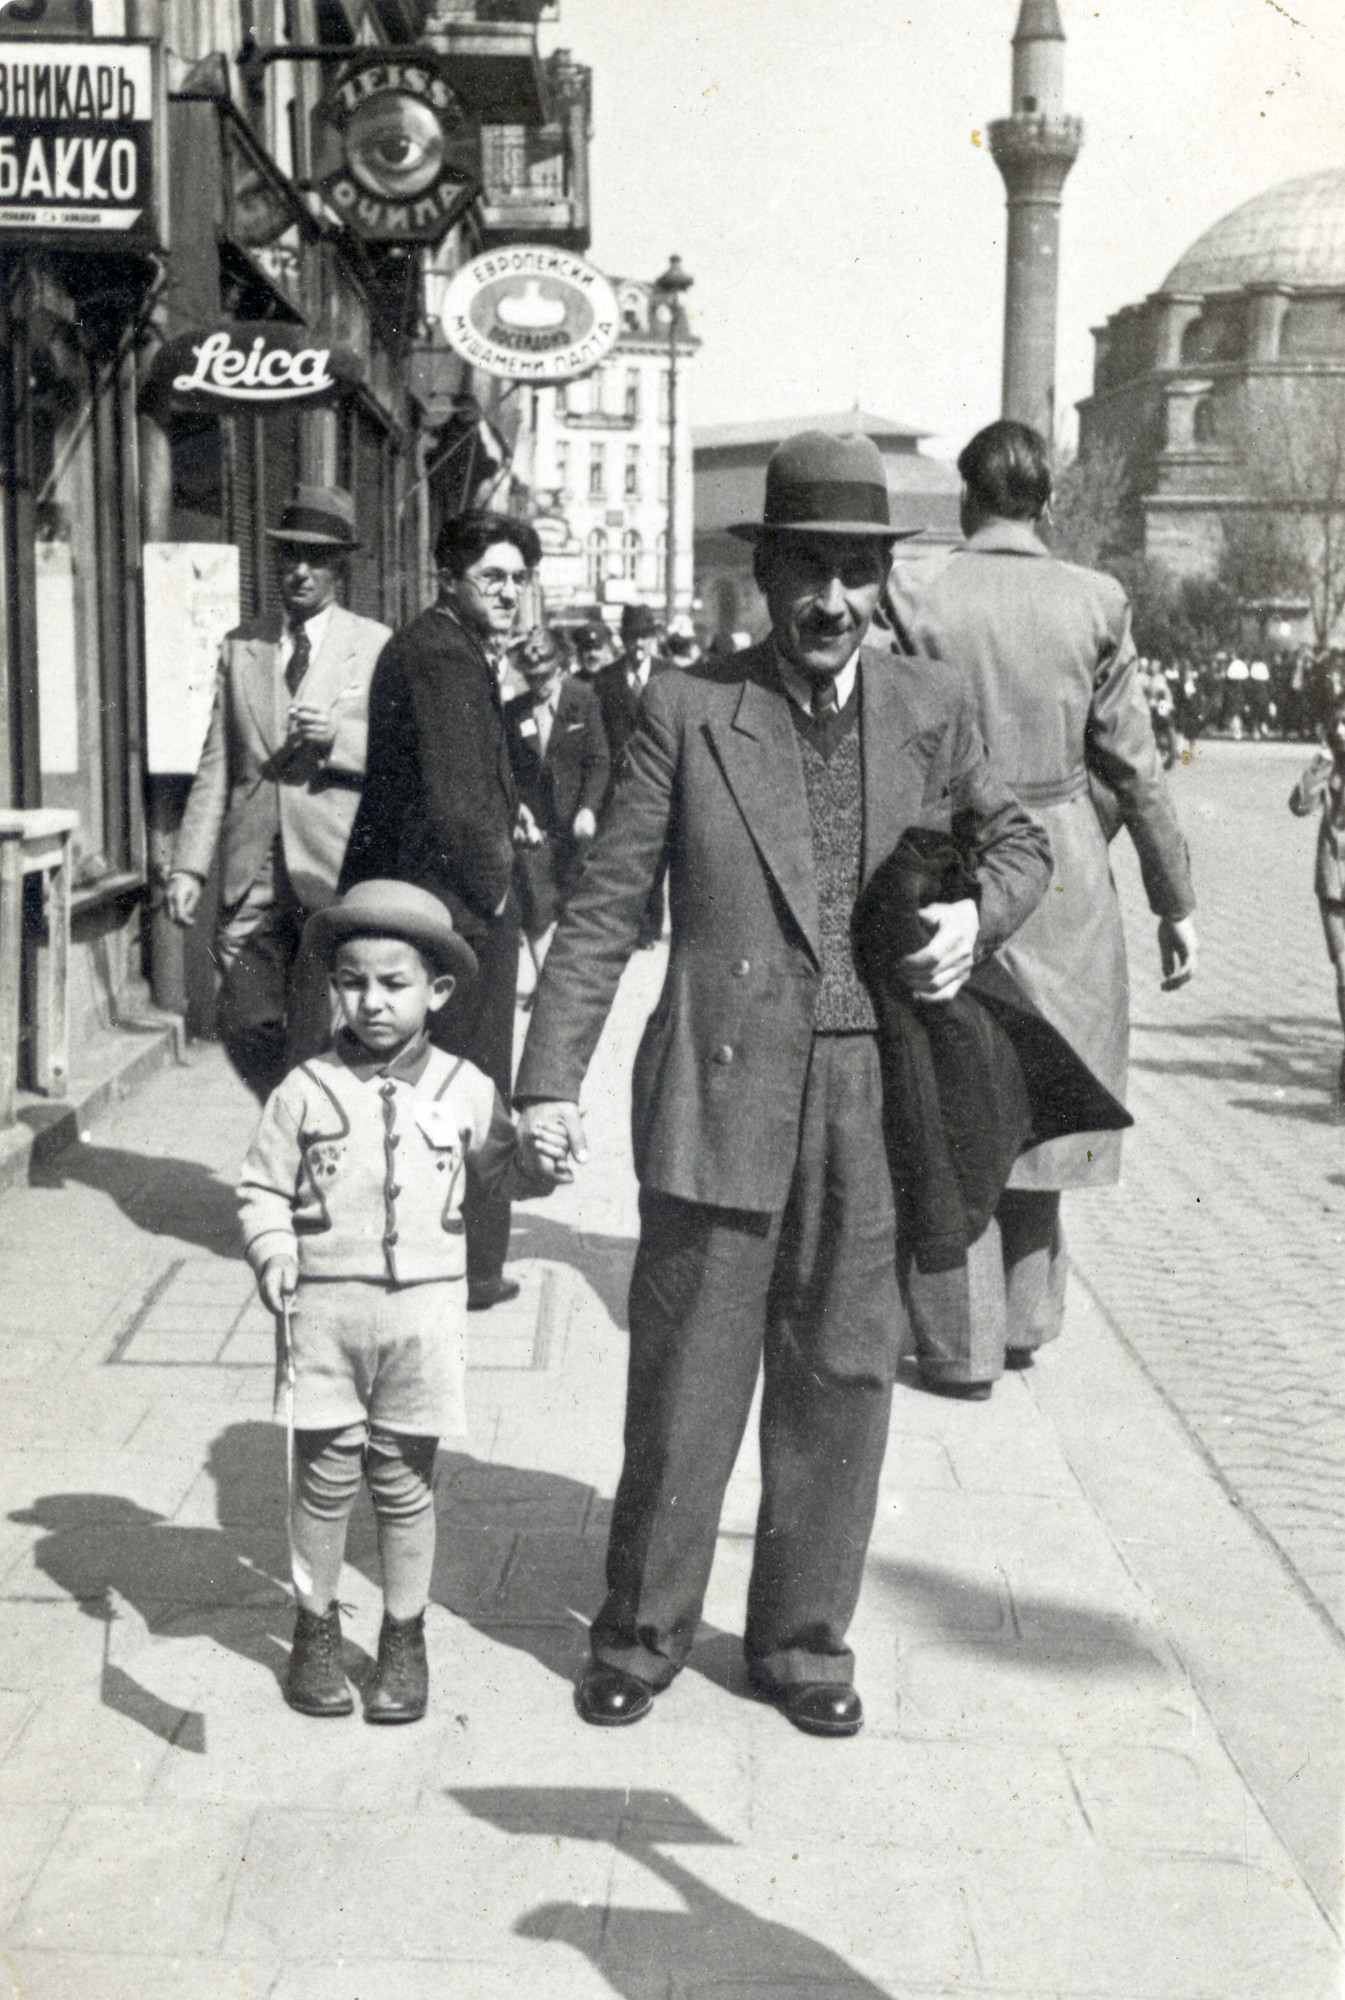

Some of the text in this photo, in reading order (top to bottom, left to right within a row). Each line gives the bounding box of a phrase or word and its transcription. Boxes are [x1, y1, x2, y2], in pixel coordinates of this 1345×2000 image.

[335, 64, 455, 110] ZEISS
[0, 136, 137, 200] БАККО
[333, 181, 467, 230] ОЧИЛА
[172, 332, 335, 400] Leica
[555, 322, 613, 370] ПАЛТА
